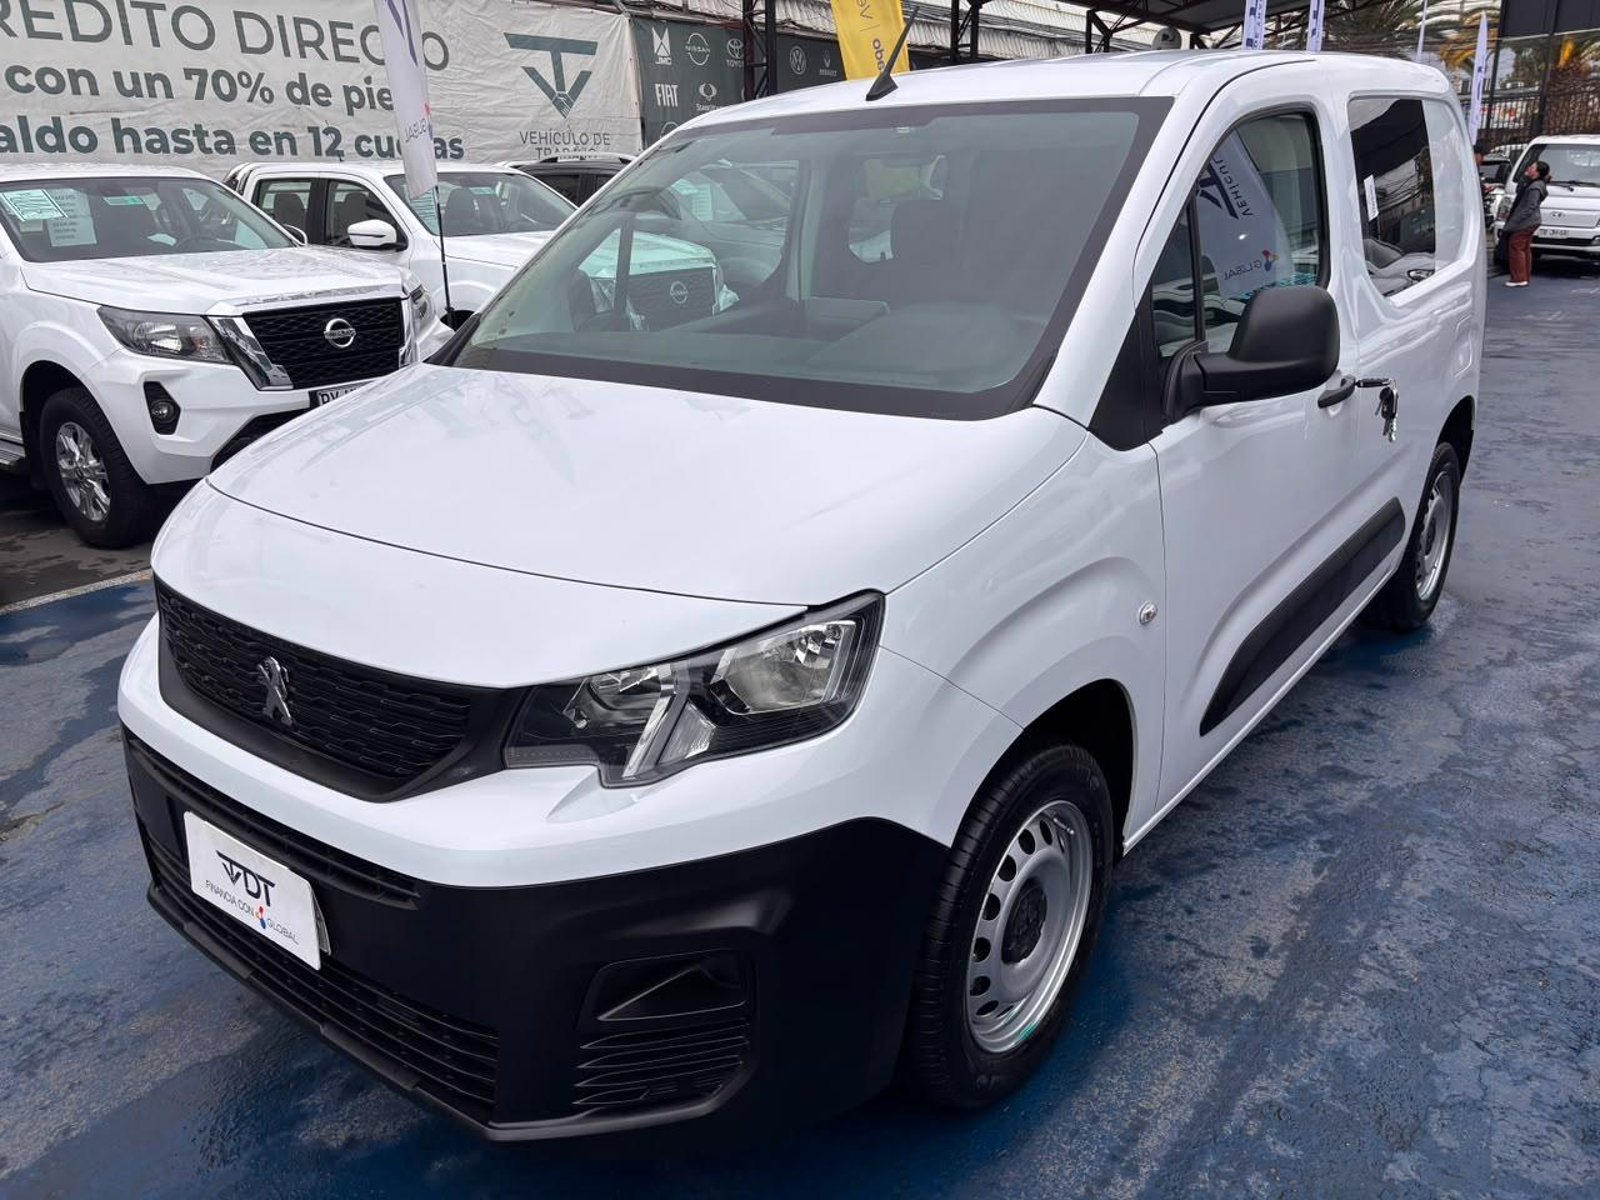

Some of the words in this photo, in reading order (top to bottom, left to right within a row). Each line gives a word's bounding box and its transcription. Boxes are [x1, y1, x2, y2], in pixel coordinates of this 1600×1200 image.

[233, 10, 449, 71] DIRECO
[4, 65, 100, 95] con
[112, 71, 174, 99] un
[183, 67, 274, 104] 70%
[286, 72, 332, 107] de
[342, 75, 394, 117] pie
[655, 83, 679, 107] FIAT
[110, 117, 236, 155] hasta
[249, 129, 298, 156] en
[307, 126, 344, 158] 12
[354, 133, 465, 159] cuas
[593, 132, 611, 146] DE
[205, 879, 237, 907] FINANCIA
[237, 899, 255, 918] CON
[266, 918, 299, 945] GLOBAL
